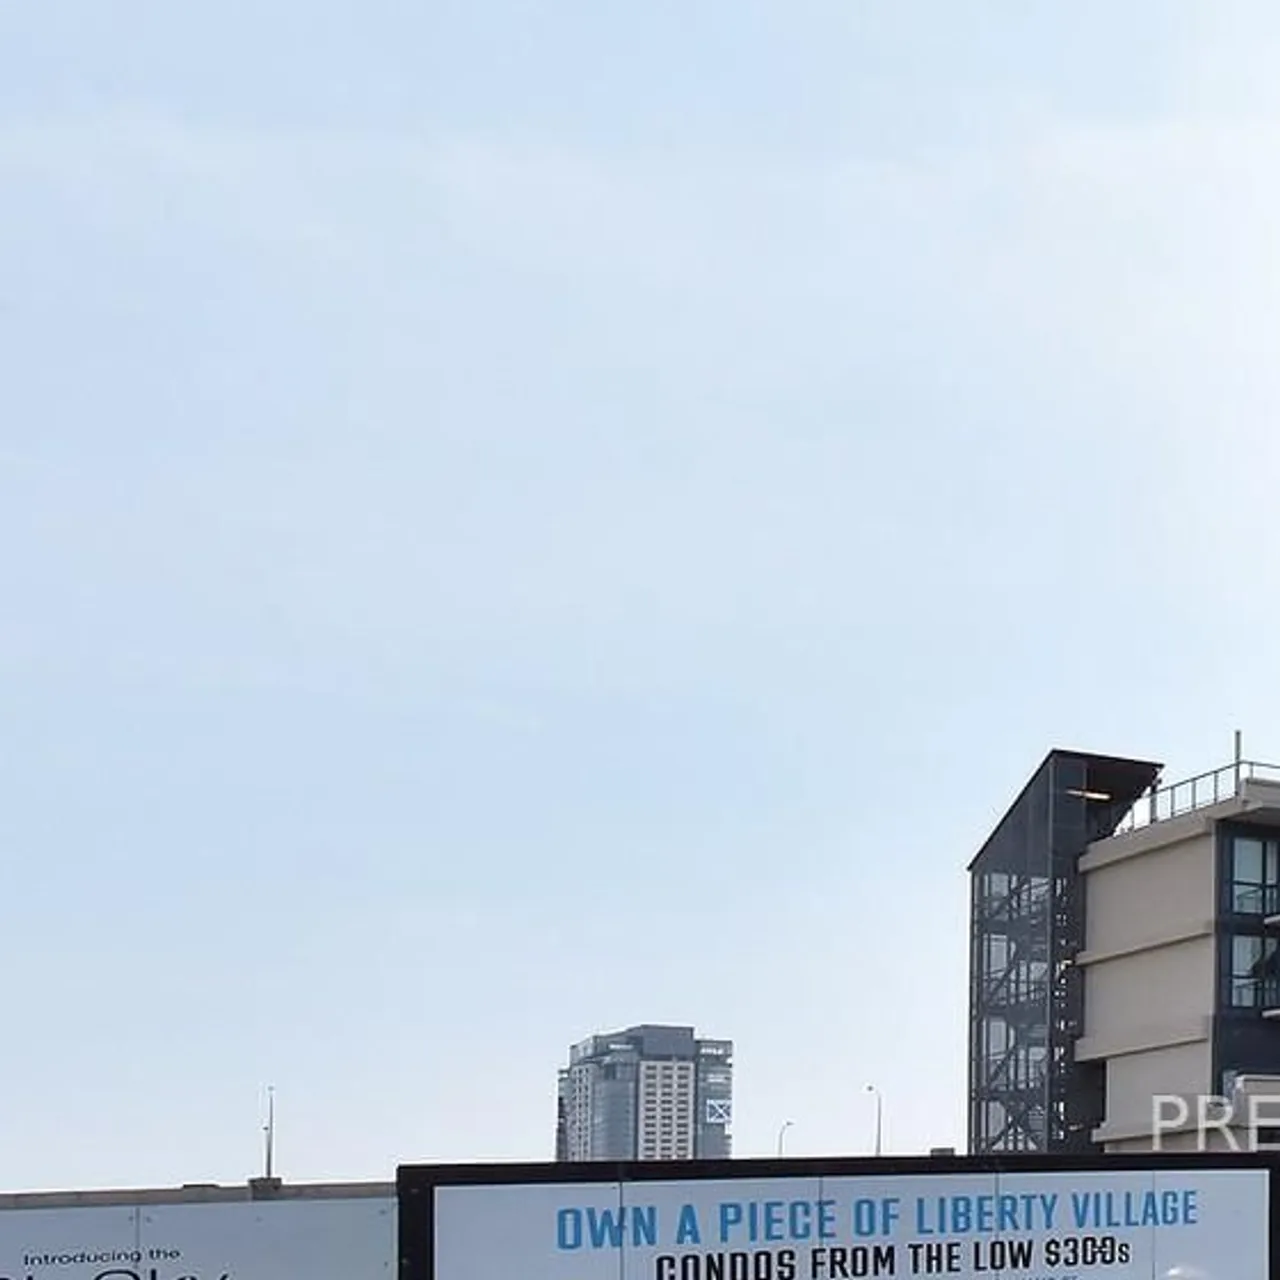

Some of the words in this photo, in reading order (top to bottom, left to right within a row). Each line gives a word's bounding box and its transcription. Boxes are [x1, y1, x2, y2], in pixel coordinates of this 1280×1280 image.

[556, 1206, 657, 1250] OWN
[676, 1203, 702, 1244] A
[719, 1198, 837, 1243] PIECE
[853, 1196, 900, 1237] OF
[916, 1193, 1059, 1234] LIBERTY
[1071, 1189, 1198, 1229] VILLAGE
[23, 1249, 142, 1266] Introducing
[148, 1248, 181, 1261] the
[655, 1248, 797, 1280] CONDOS
[810, 1245, 896, 1279] FROM
[907, 1241, 962, 1274] THE
[973, 1239, 1034, 1270] LOW
[1044, 1234, 1131, 1267] $300s
